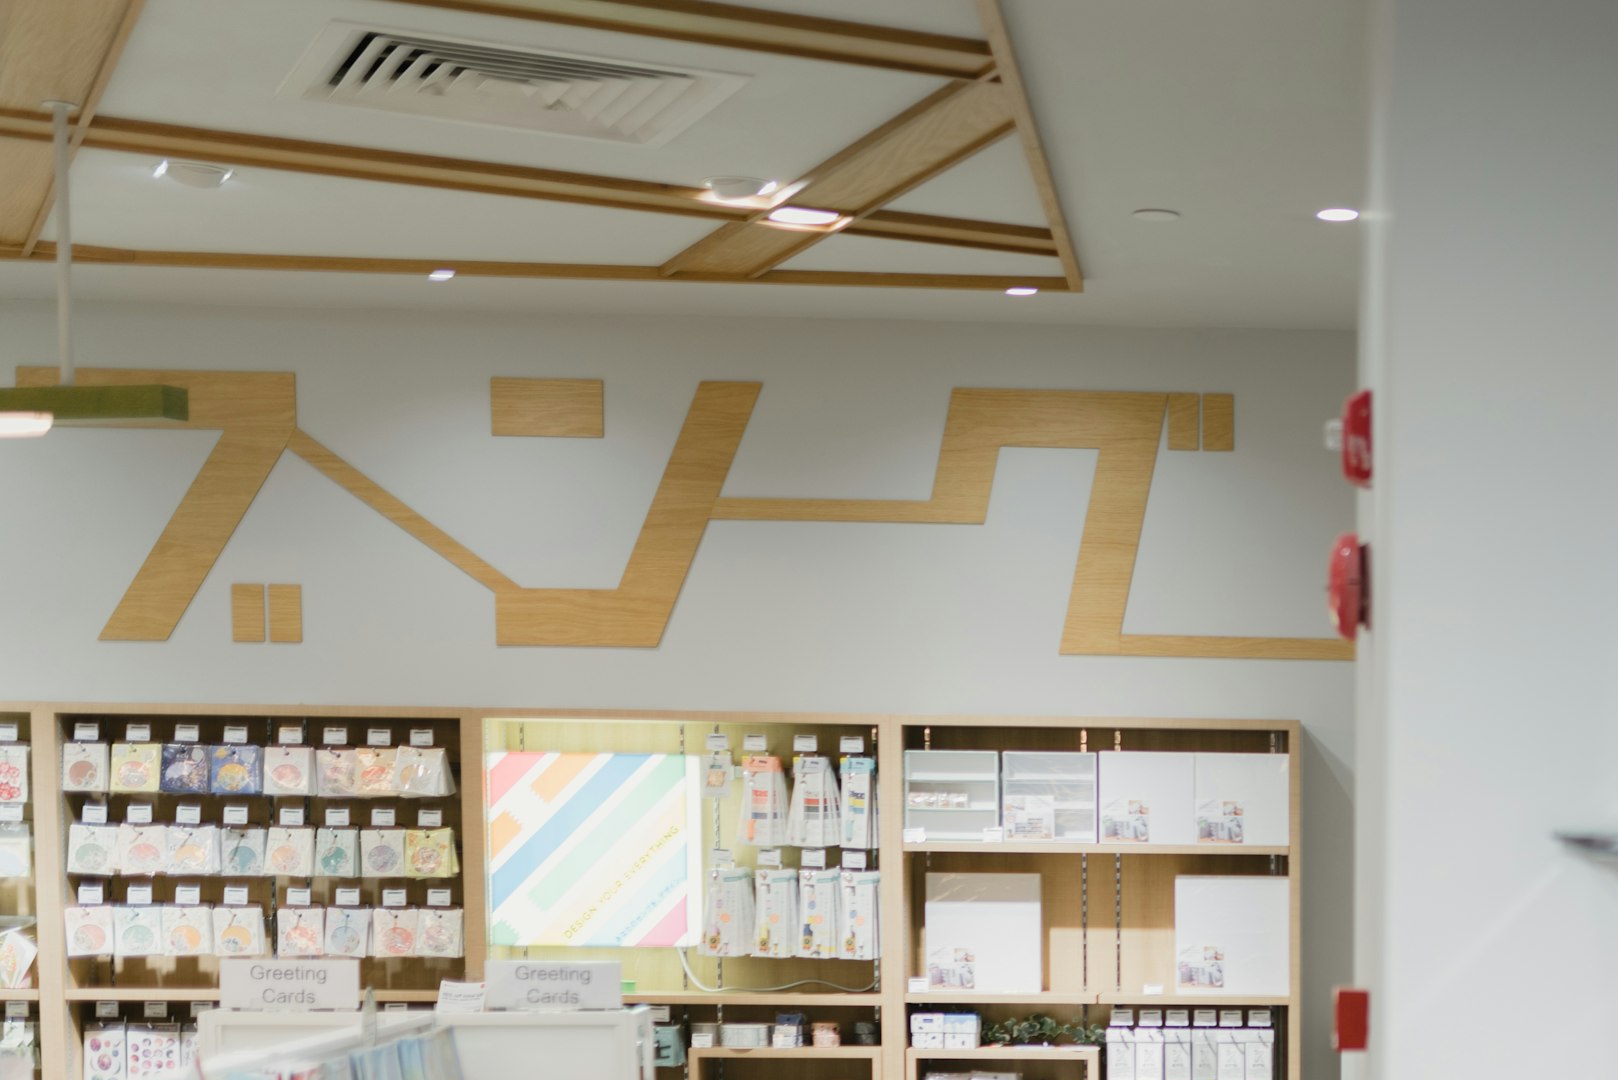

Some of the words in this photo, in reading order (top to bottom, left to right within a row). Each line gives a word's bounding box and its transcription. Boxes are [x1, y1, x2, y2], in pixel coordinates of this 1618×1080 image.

[563, 905, 597, 939] DESIGN
[599, 880, 623, 903] YOUR
[623, 825, 680, 880] EVERYTHING
[249, 964, 327, 985] Greeting
[514, 965, 591, 985] Greeting
[262, 987, 316, 1004] Cards
[526, 988, 580, 1004] Cards
